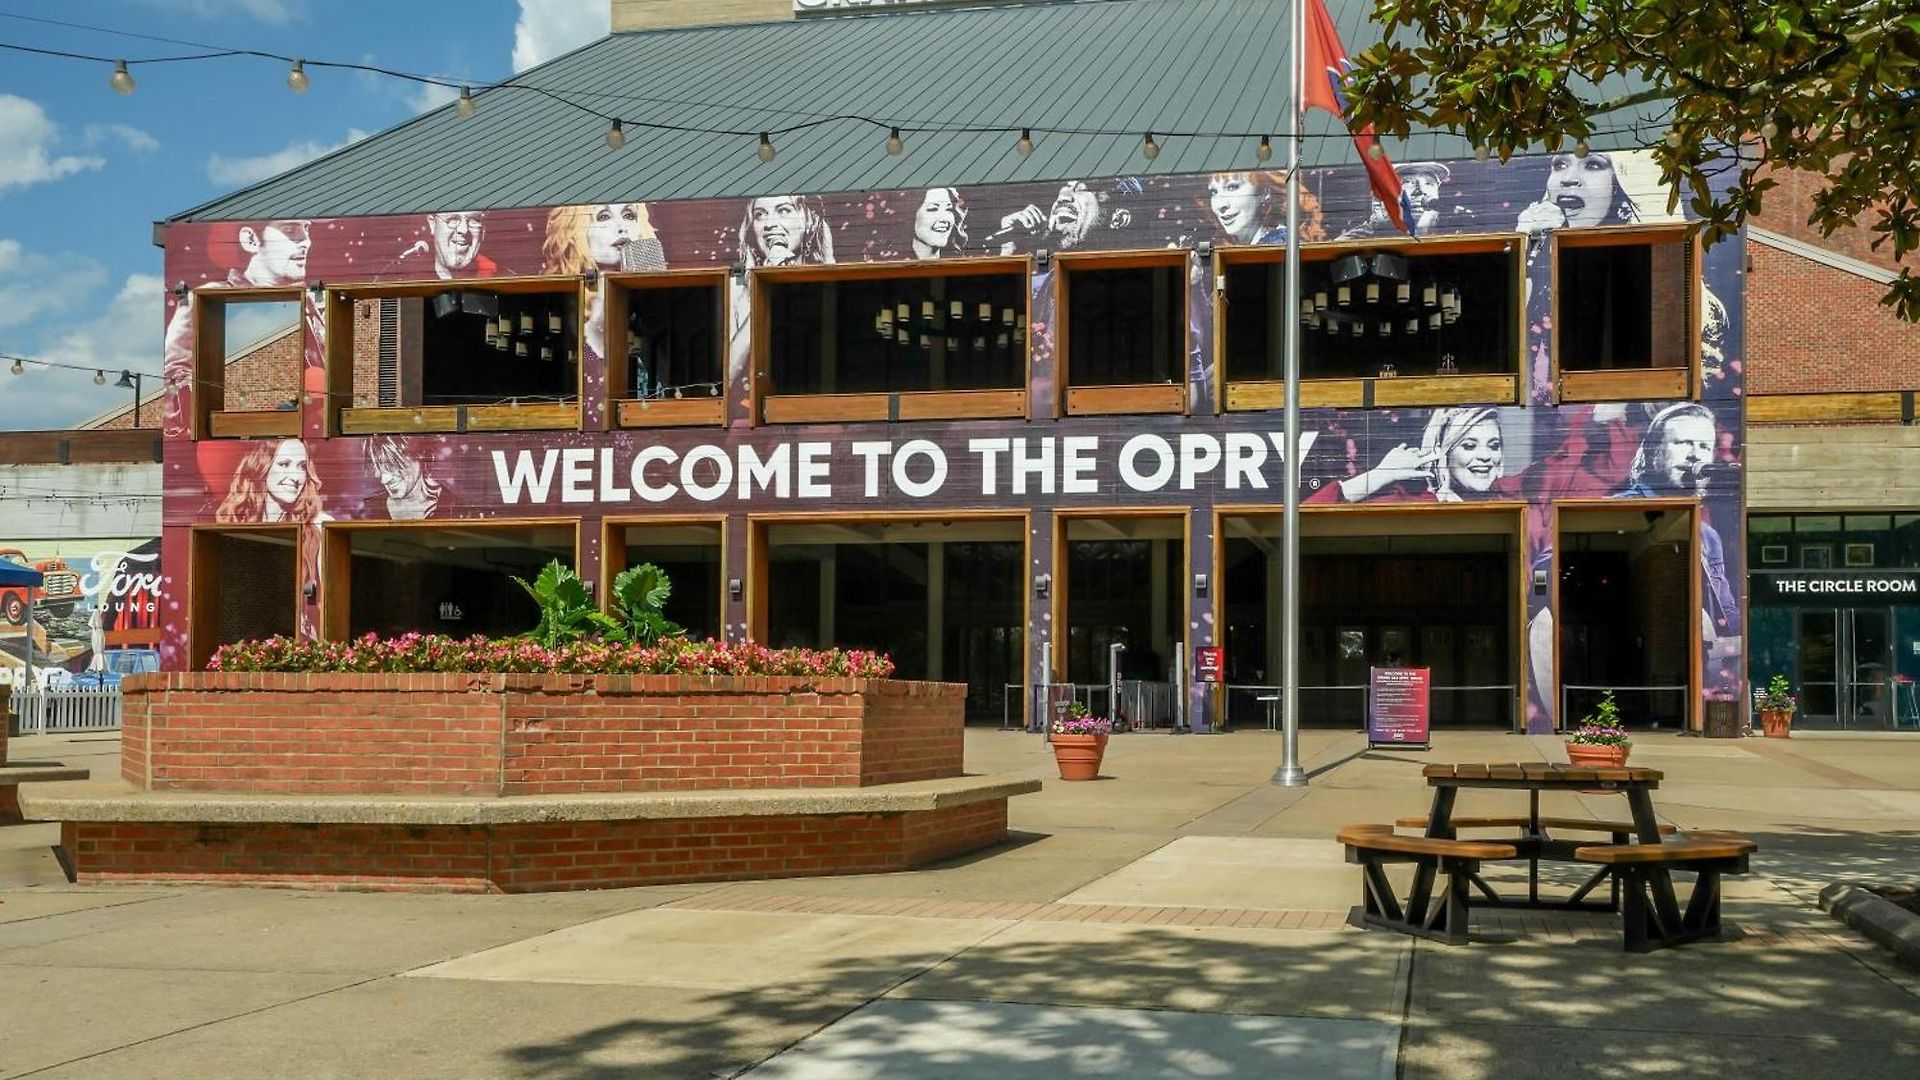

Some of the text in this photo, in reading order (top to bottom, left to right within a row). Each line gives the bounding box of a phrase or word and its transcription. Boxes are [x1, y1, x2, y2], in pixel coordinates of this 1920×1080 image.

[491, 442, 832, 504] WELCOME
[851, 437, 948, 498] TO
[968, 435, 1099, 495] THE
[1776, 579, 1917, 593] THE CIRCLE ROOM
[87, 602, 156, 612] LOUNG
